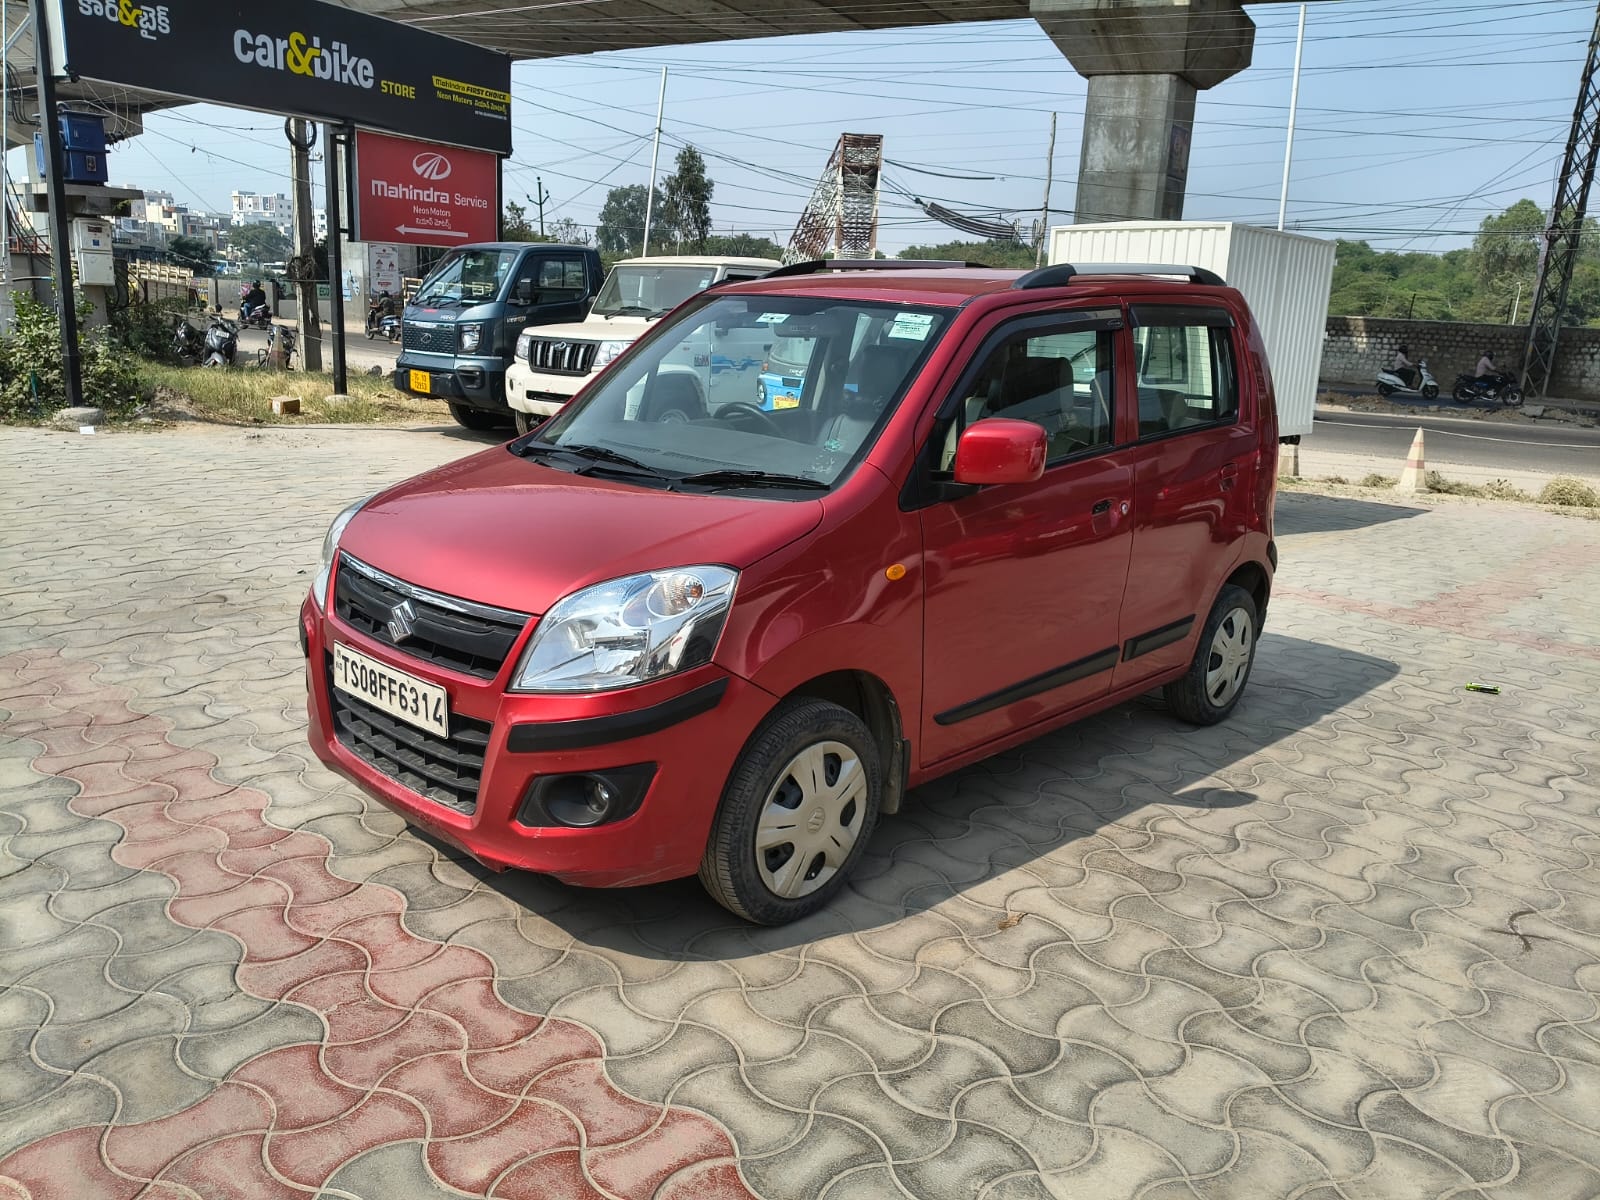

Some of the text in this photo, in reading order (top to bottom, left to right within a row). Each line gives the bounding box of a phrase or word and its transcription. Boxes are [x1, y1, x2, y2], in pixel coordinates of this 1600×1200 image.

[233, 29, 416, 99] car&bike STORE
[435, 79, 507, 101] Mahindra FIRST CHOICE
[436, 91, 452, 101] Neon
[452, 94, 473, 106] Motors
[371, 179, 488, 209] Mahindra Service
[412, 205, 452, 218] Neon Motors
[342, 655, 443, 727] TS08FF6314
